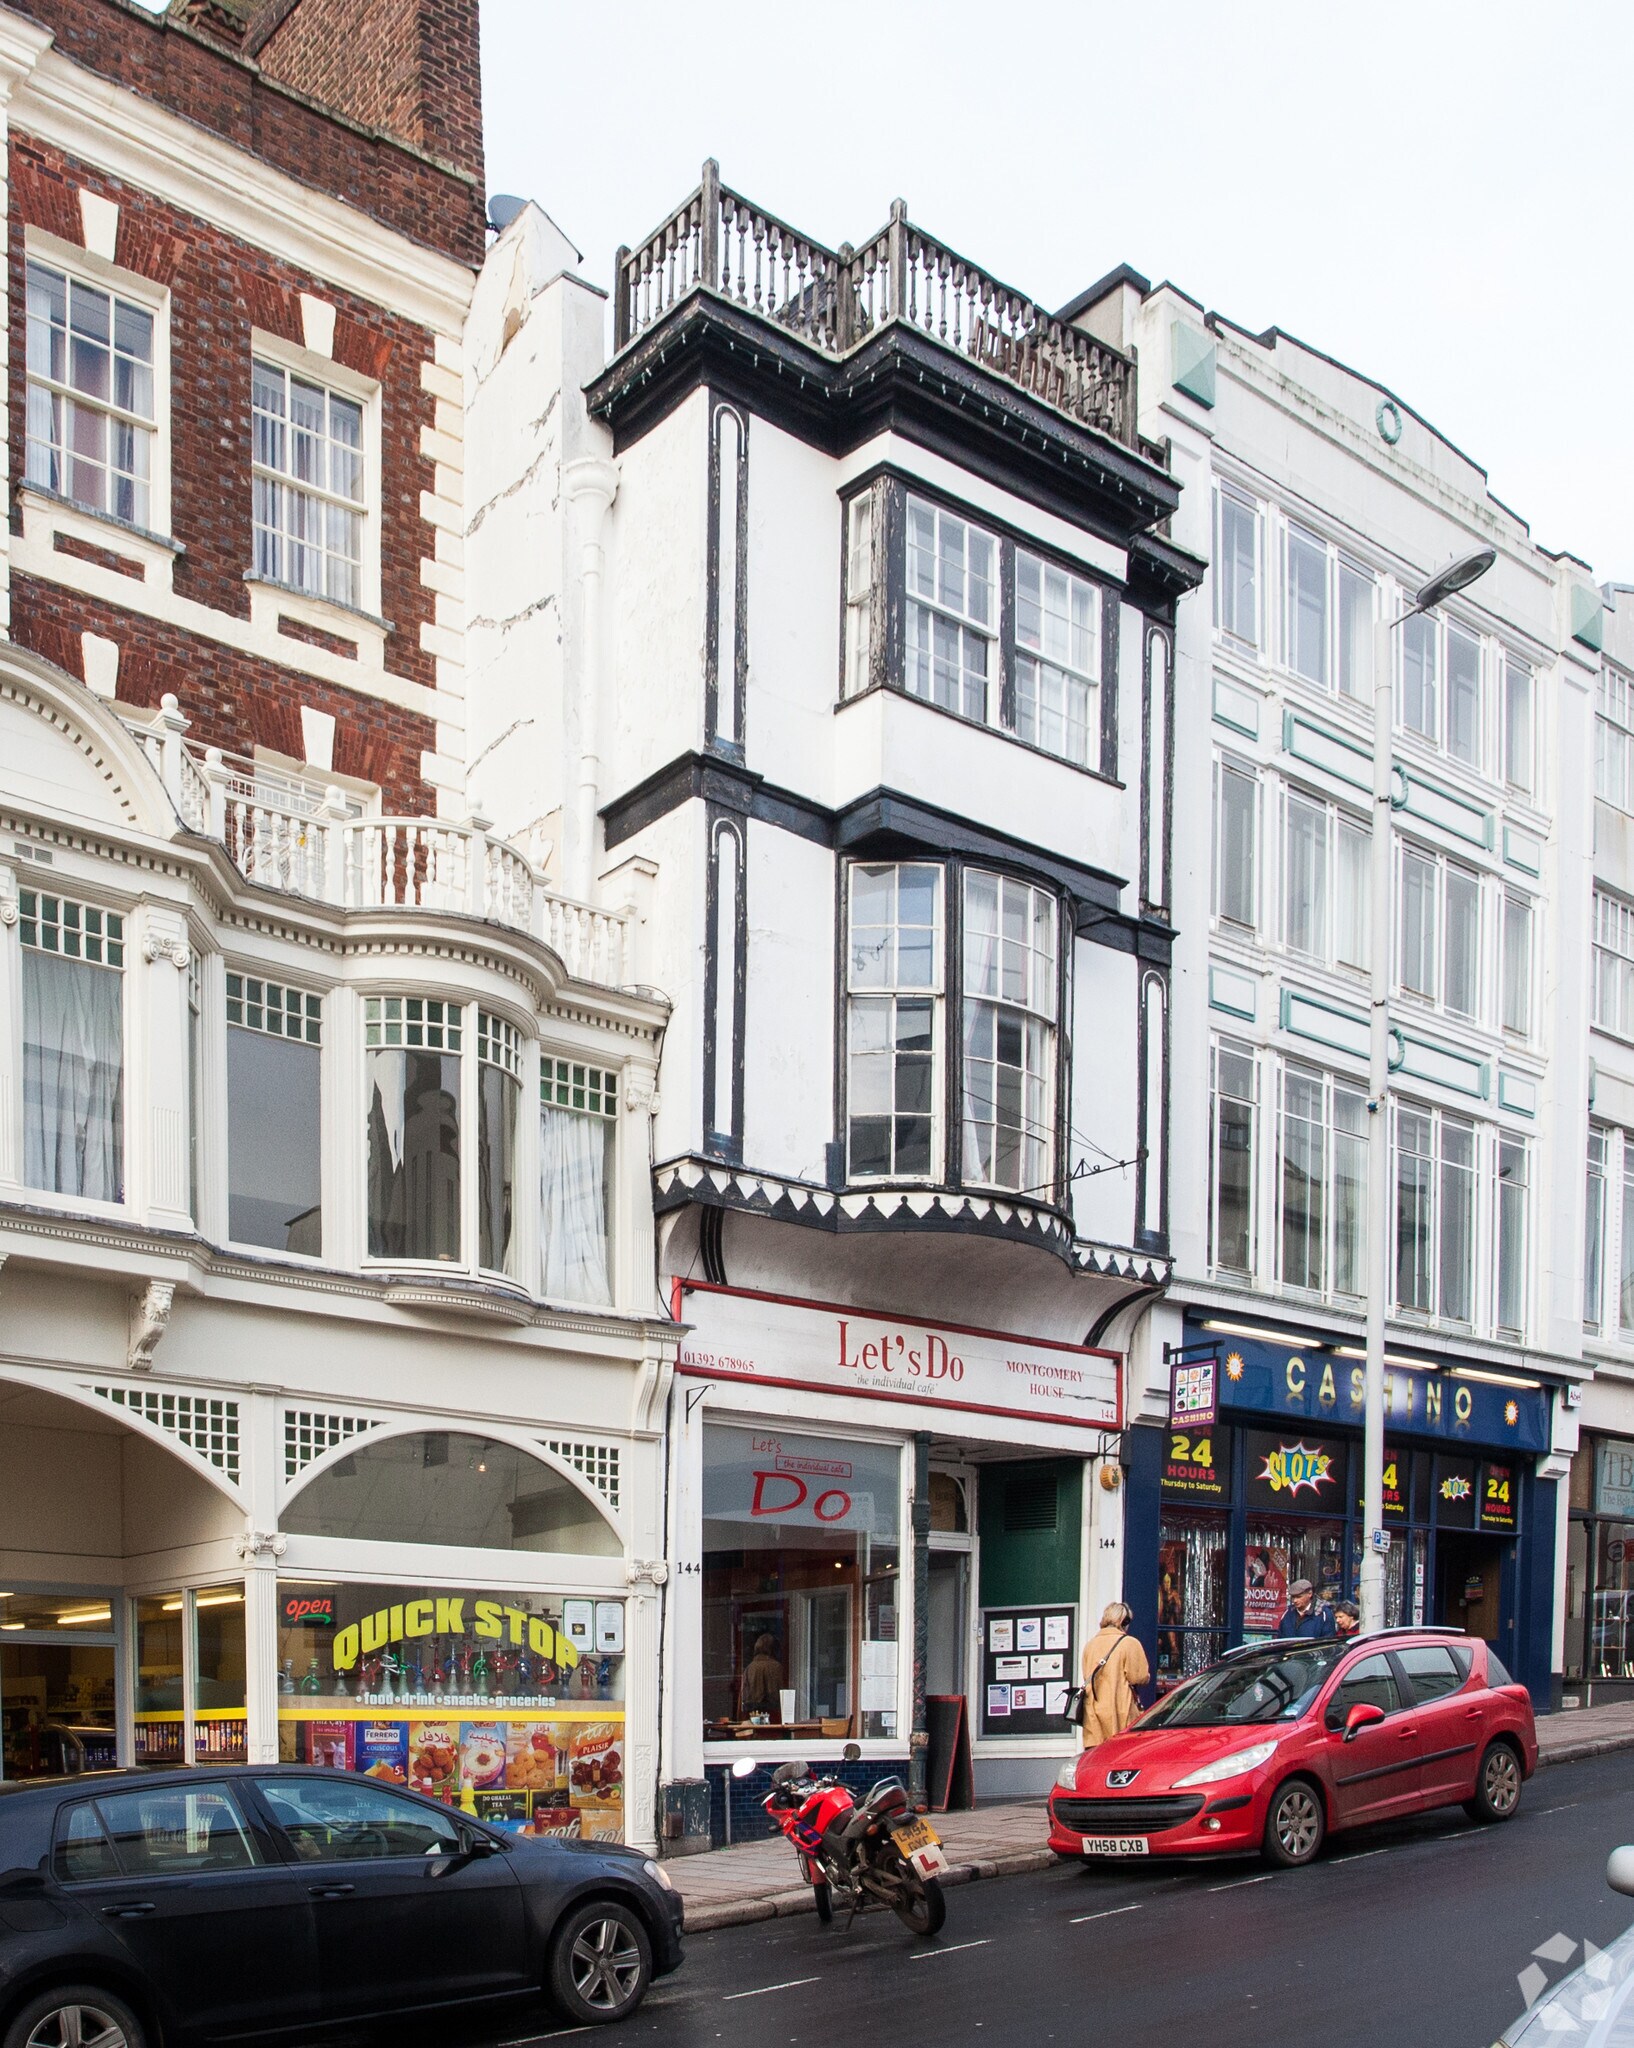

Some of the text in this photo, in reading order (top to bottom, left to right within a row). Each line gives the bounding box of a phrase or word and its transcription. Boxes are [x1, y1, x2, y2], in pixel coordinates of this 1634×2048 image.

[837, 1320, 964, 1382] Let's Do
[684, 1351, 755, 1372] 01392 678965
[1006, 1360, 1084, 1383] MONTGOMERY
[872, 1375, 916, 1391] individual
[1030, 1383, 1065, 1399] HOUSE
[1286, 1356, 1473, 1421] CASHINO
[1101, 1408, 1114, 1420] 144
[1171, 1411, 1214, 1425] CASHINO
[752, 1437, 782, 1453] Let's
[1171, 1435, 1213, 1468] 24
[784, 1460, 794, 1468] the
[797, 1461, 830, 1472] individual
[1167, 1465, 1216, 1480] HOURS
[1269, 1451, 1330, 1491] SLOTS
[1383, 1464, 1398, 1489] 4
[1161, 1478, 1222, 1493] Thursday to Saturday
[1487, 1478, 1509, 1503] 24
[751, 1471, 852, 1522] Do
[1485, 1503, 1511, 1515] HOURS
[1099, 1538, 1116, 1549] 144
[677, 1562, 701, 1575] 144
[1244, 1588, 1280, 1601] ONOPOLY
[286, 1599, 332, 1622] open
[333, 1598, 578, 1671] QUICK STOP
[364, 1692, 556, 1708] food drink snacks groceries
[366, 1730, 399, 1739] FERRERO
[582, 1741, 609, 1754] PLAISIR
[1087, 1840, 1144, 1852] YH58 CXB
[918, 1853, 940, 1872] L
